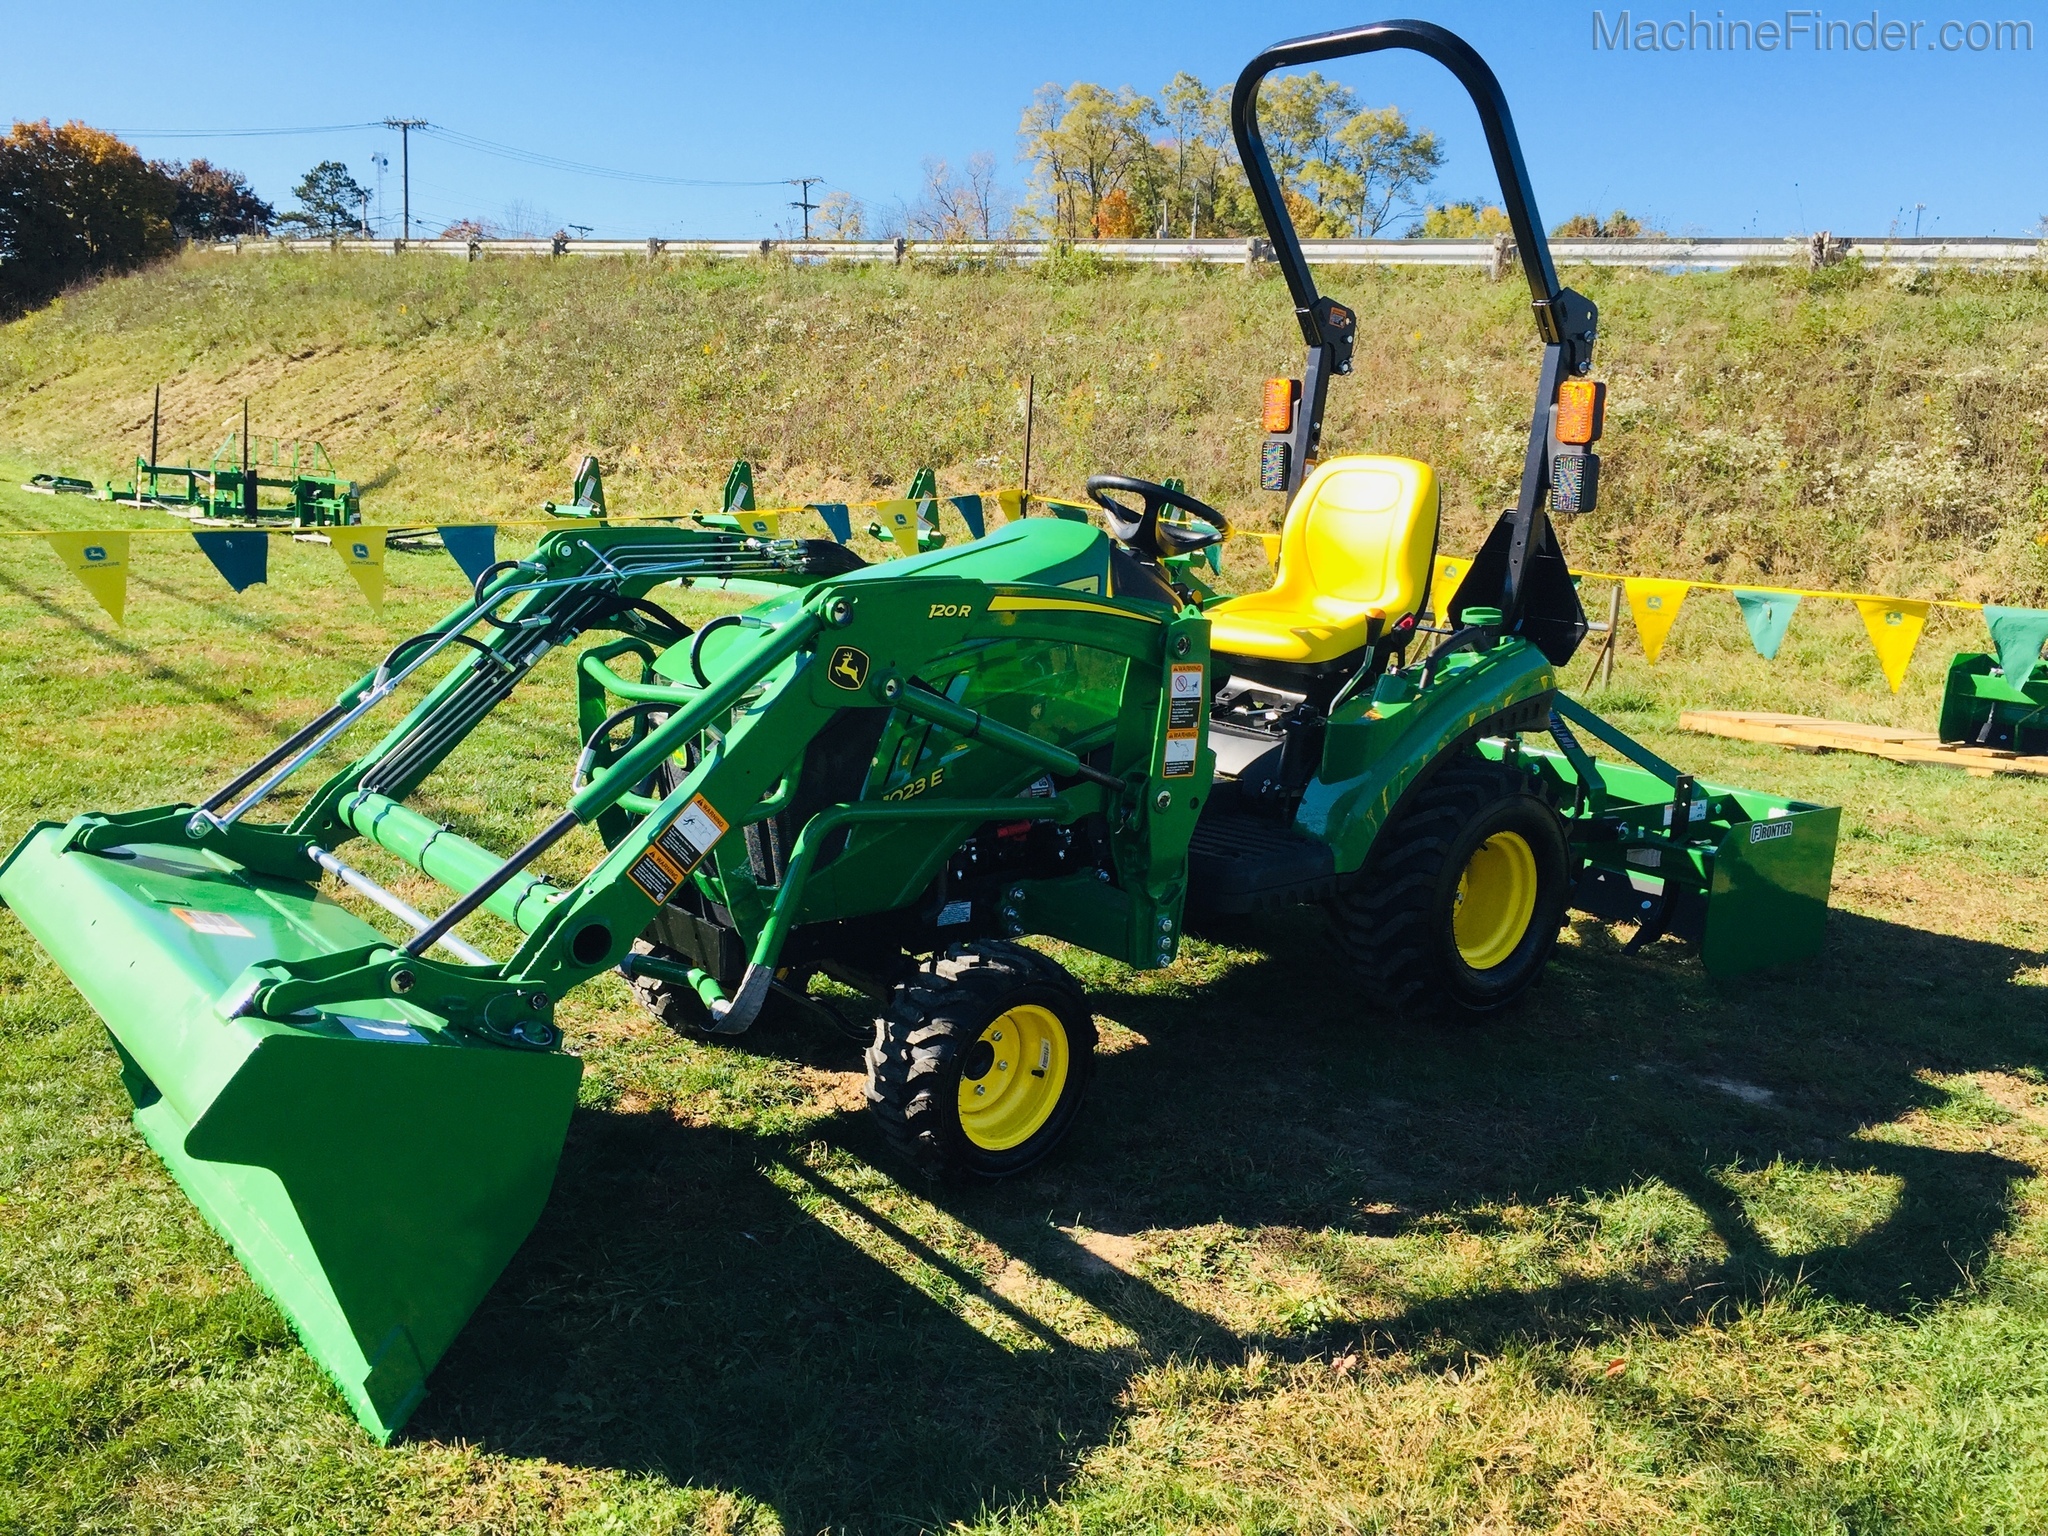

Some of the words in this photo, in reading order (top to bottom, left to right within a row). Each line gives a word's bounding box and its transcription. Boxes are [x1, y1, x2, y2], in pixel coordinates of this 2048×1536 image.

[928, 604, 957, 619] 120
[958, 604, 972, 617] R
[930, 767, 944, 788] E
[702, 802, 725, 828] WARNING
[1751, 822, 1792, 842] FRONTIER
[655, 854, 679, 881] WARNING
